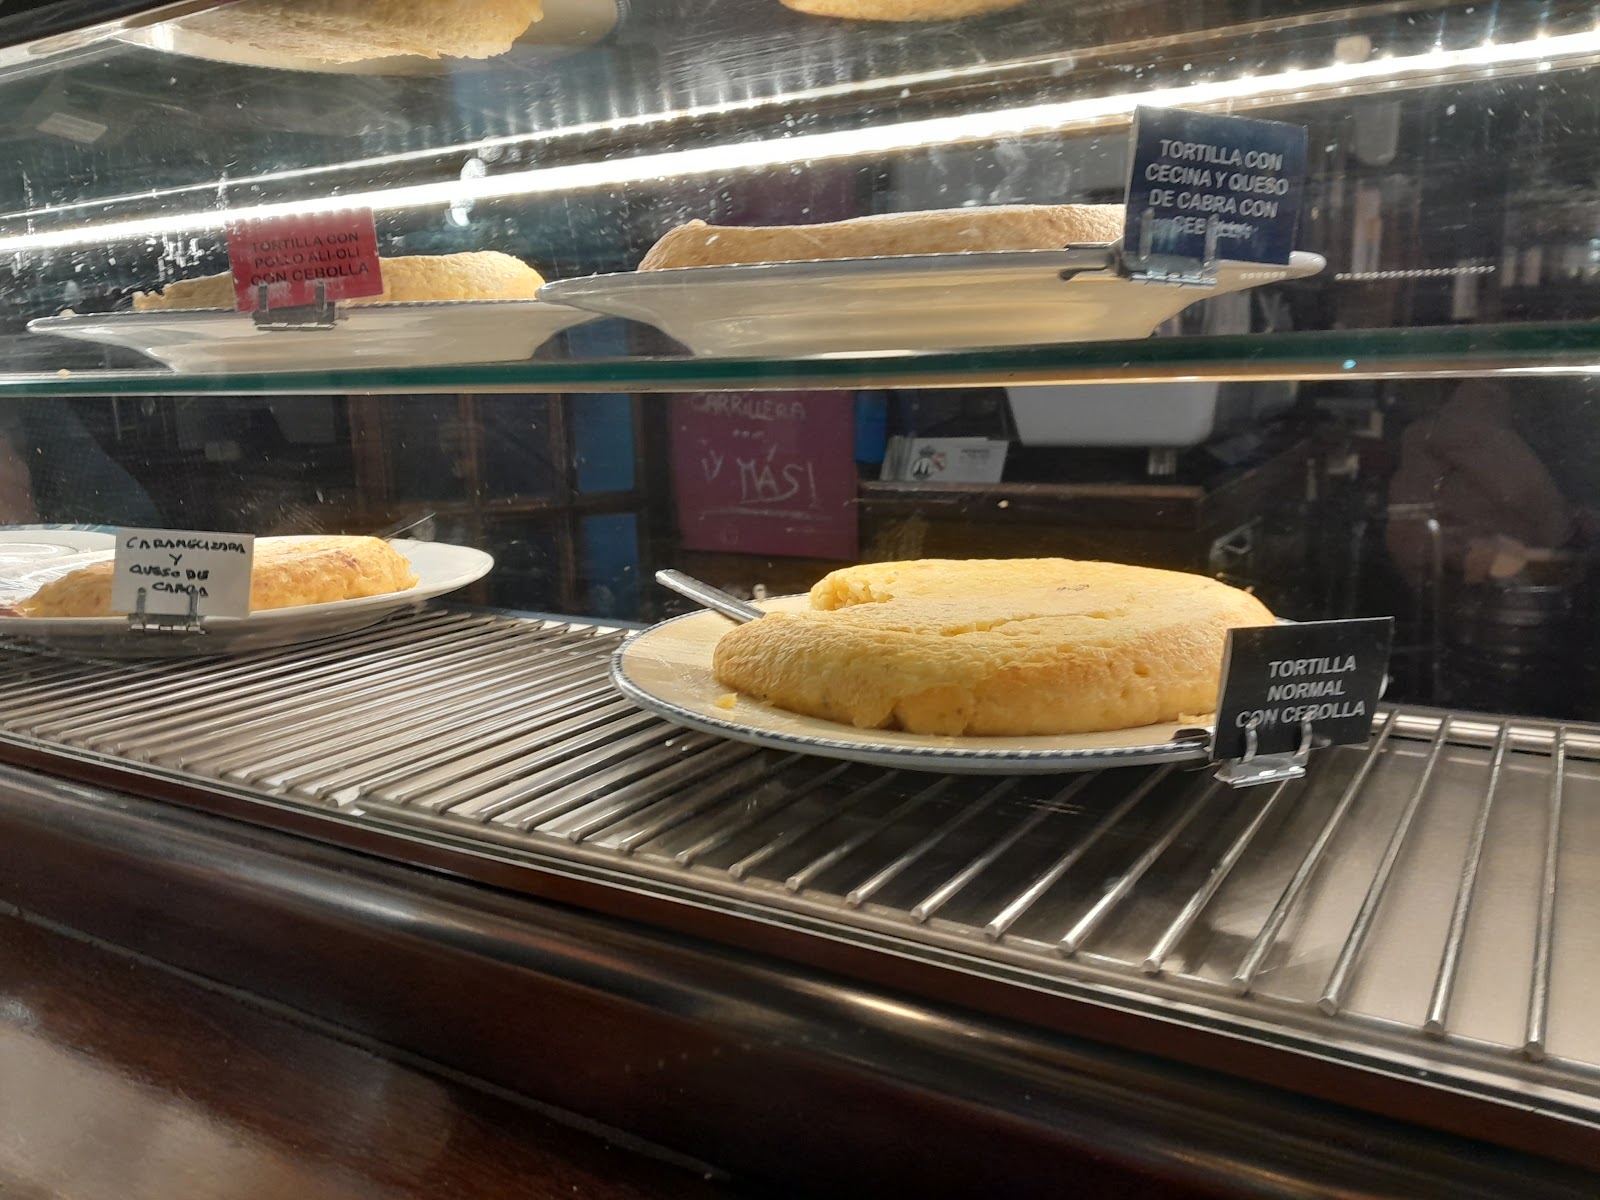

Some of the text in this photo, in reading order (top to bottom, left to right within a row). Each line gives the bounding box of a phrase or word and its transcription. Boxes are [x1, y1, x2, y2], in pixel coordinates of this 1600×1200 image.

[1160, 139, 1283, 171] TORTILLA CON
[1145, 162, 1290, 196] CECINA Y QUESO
[1149, 188, 1279, 219] DE CABRA CON
[252, 231, 359, 253] TORTILLA CON
[254, 247, 360, 269] POLLO ALI-OLI
[251, 262, 369, 286] CON CEBOLLA
[129, 564, 180, 578] QUESO
[168, 553, 183, 566] Y
[1268, 655, 1357, 678] TORTILLA
[1266, 679, 1347, 702] NORMAL
[1235, 708, 1280, 728] CON
